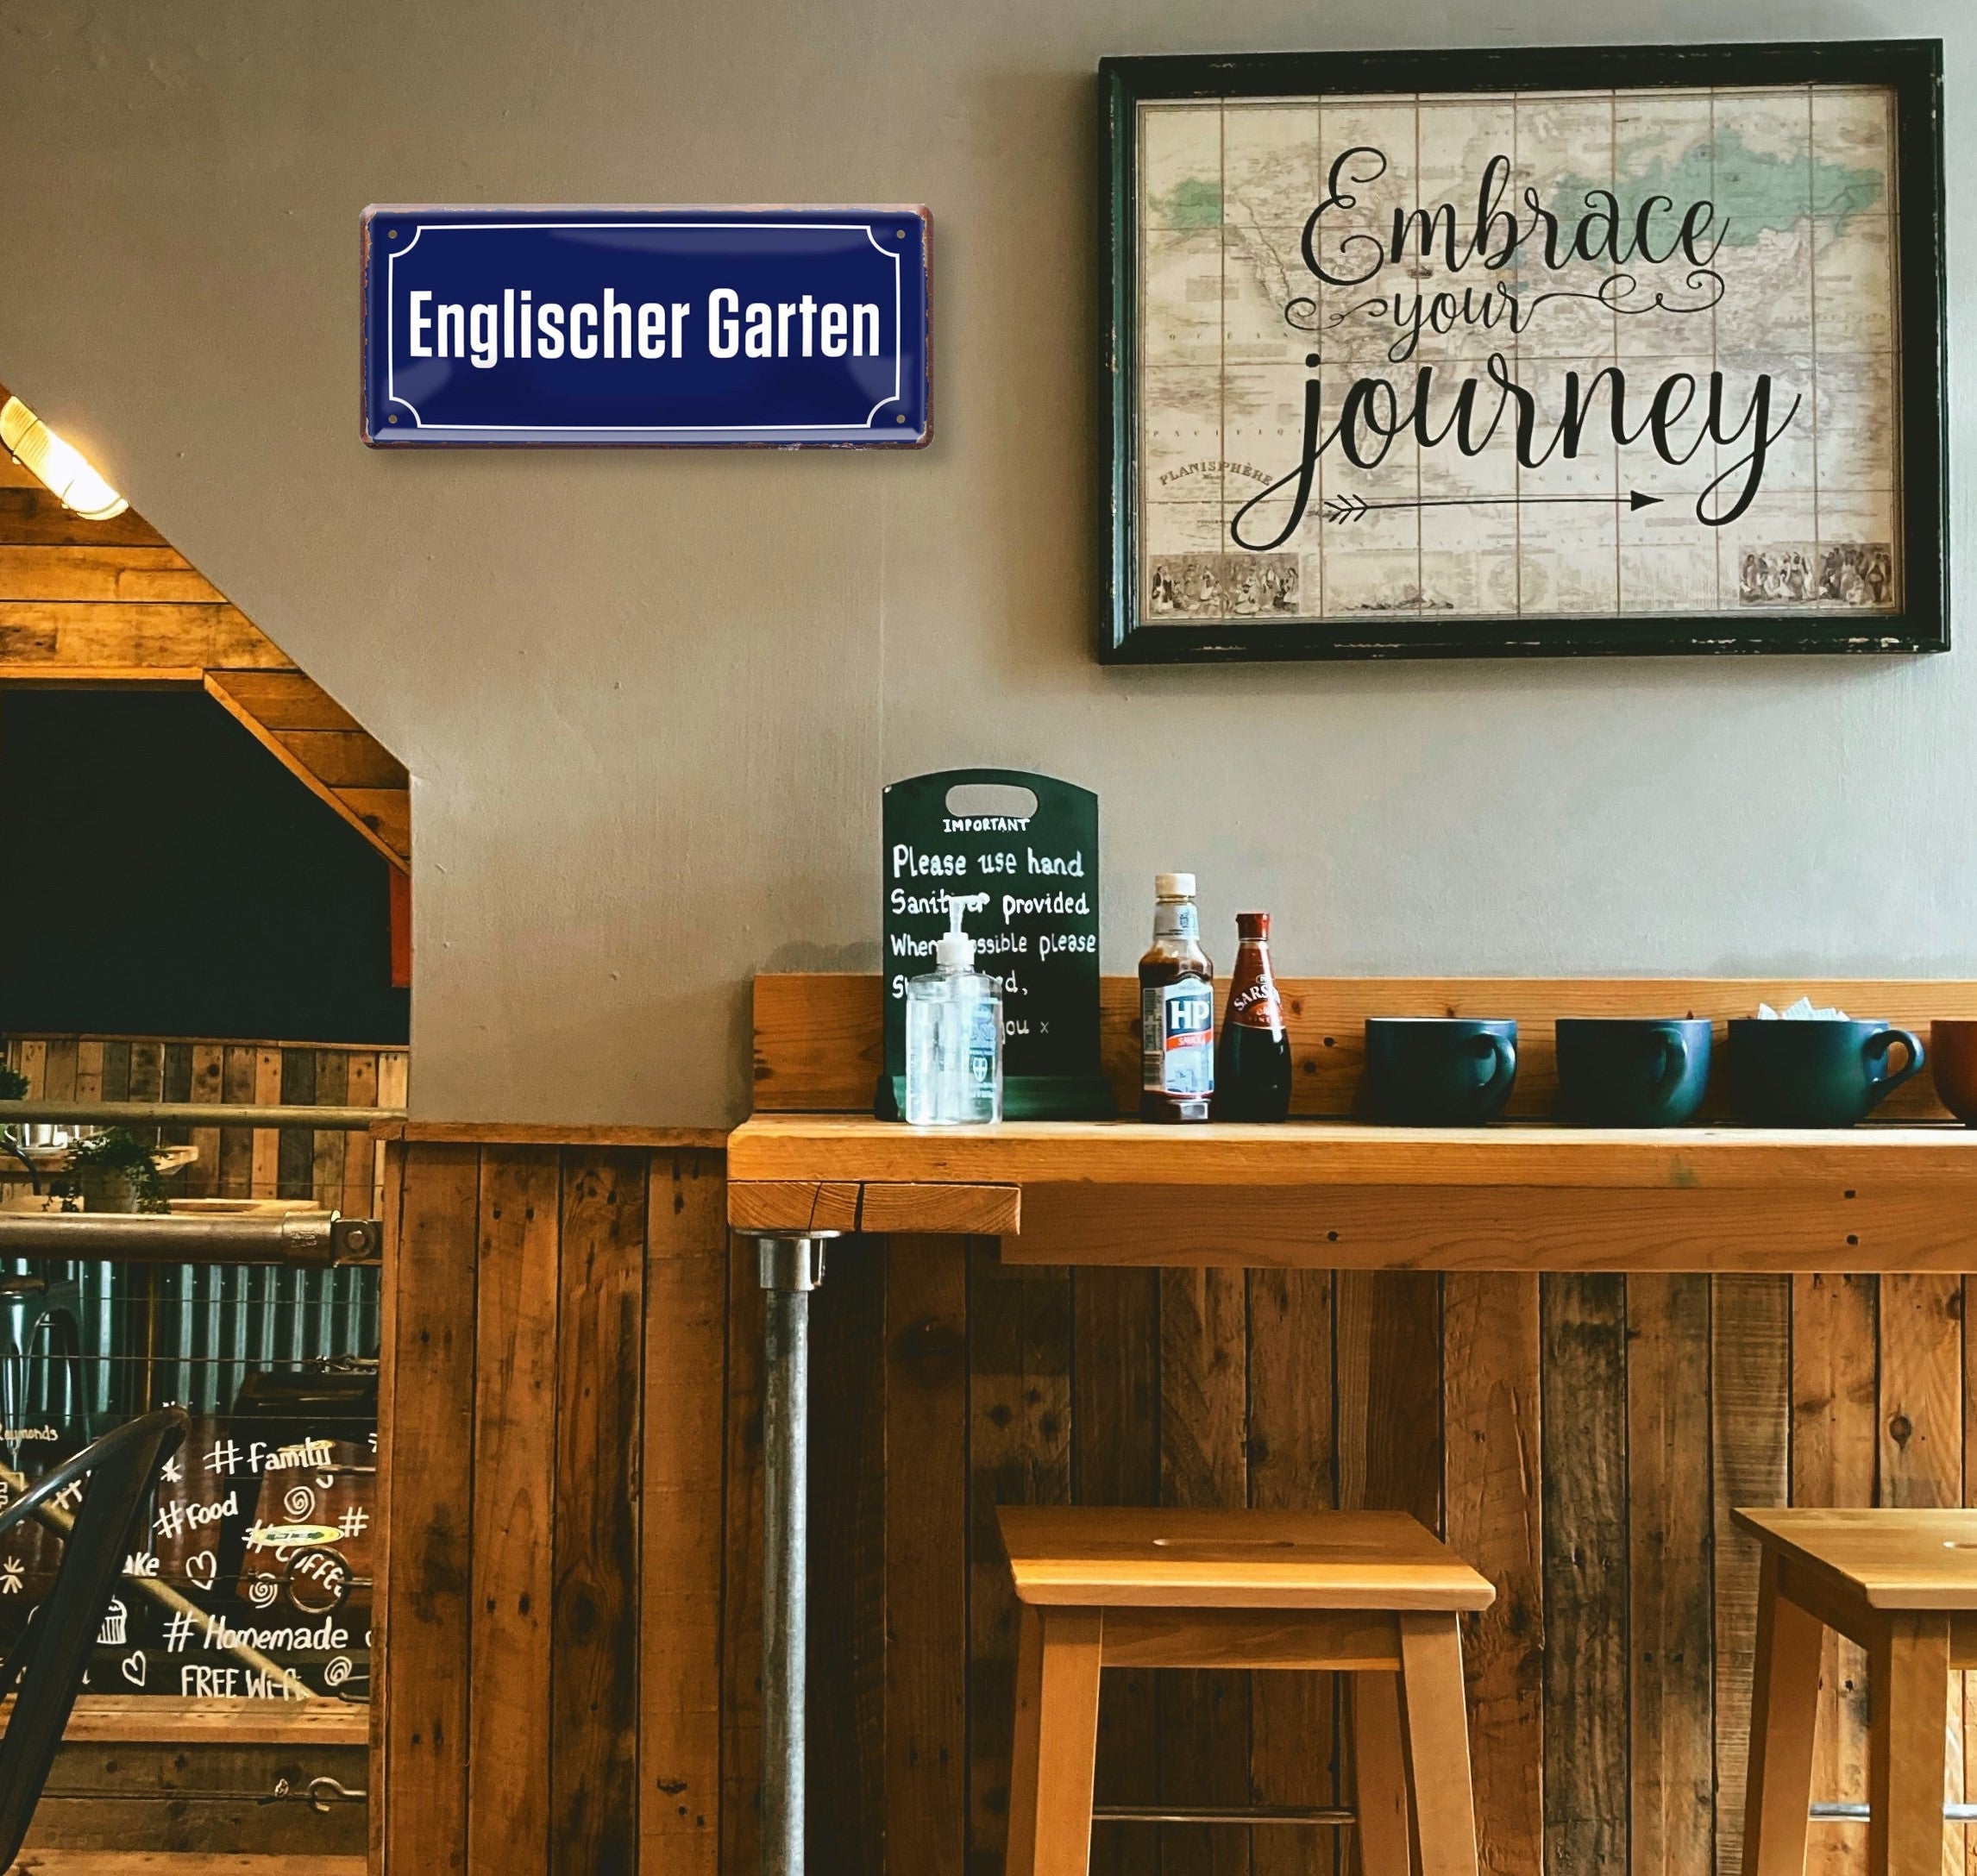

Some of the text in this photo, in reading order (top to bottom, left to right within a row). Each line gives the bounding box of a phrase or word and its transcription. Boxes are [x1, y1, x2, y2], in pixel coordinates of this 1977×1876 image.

[1301, 147, 1729, 285] Embrace
[410, 287, 880, 369] Englischer Garten
[1231, 352, 1802, 551] journey
[1159, 461, 1274, 486] PLANISPHÈRE
[942, 818, 1031, 832] IMPORTANT
[893, 844, 1084, 878] Please use hand
[1002, 891, 1090, 925] provided
[972, 932, 1027, 955] ssible
[1039, 932, 1096, 962] please
[1171, 1001, 1210, 1030] HP
[181, 1665, 240, 1699] FREE
